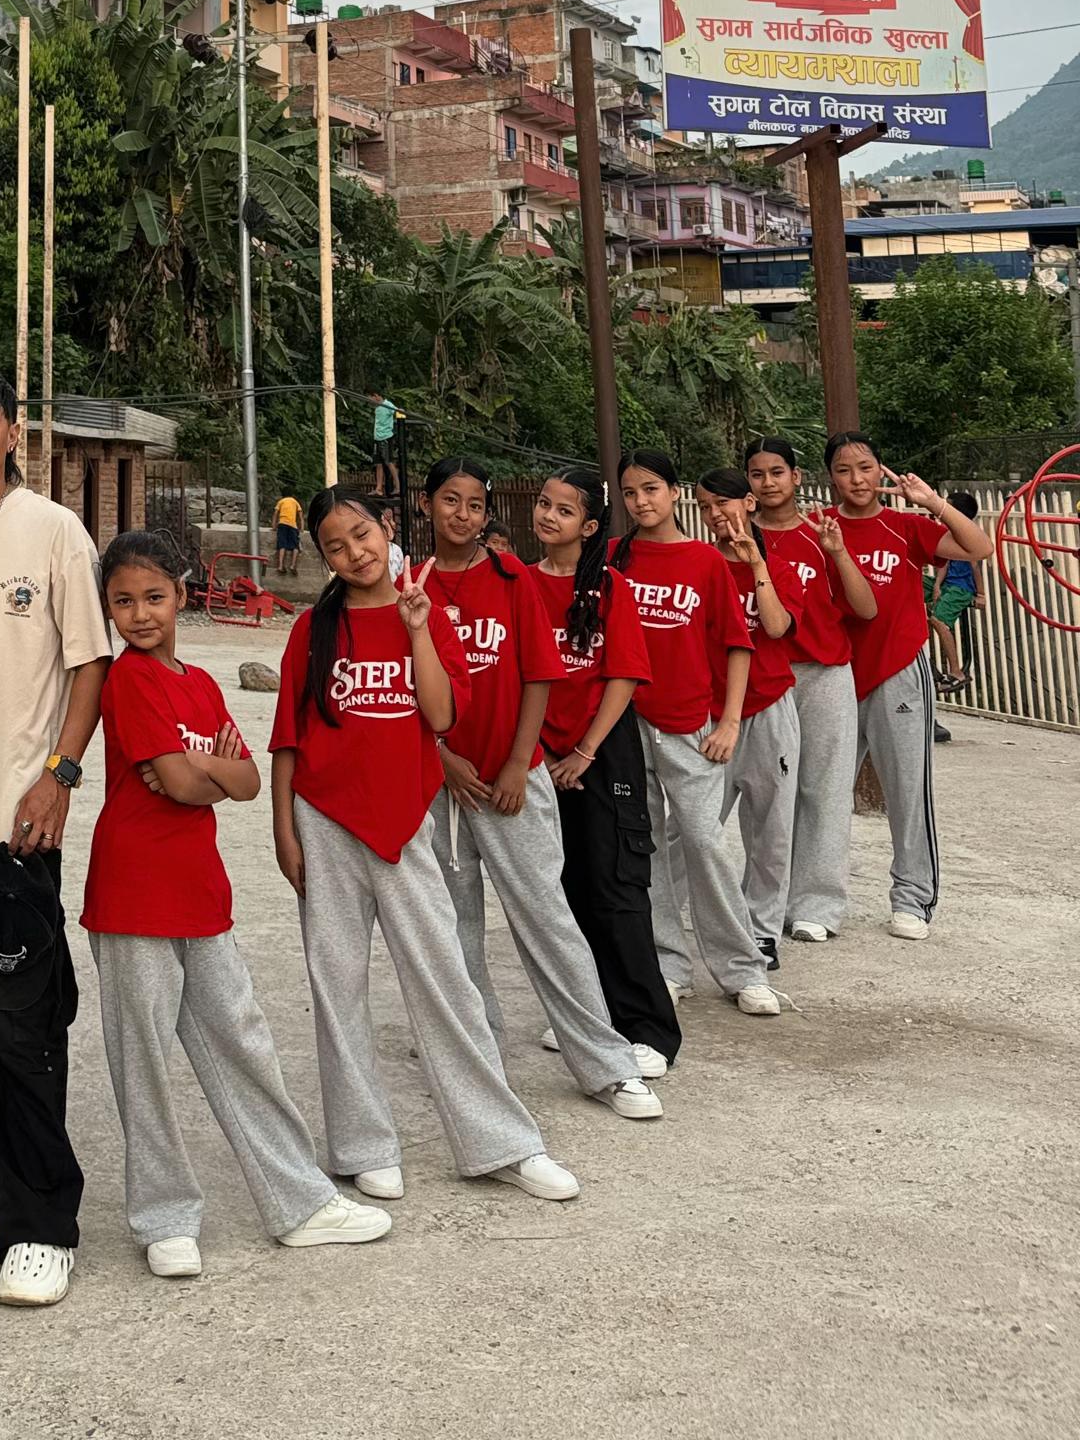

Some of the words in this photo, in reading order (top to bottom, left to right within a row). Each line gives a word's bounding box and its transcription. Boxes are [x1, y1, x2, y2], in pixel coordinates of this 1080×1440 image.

[696, 17, 754, 41] सुगम
[763, 18, 873, 45] सार्वजनिक
[883, 28, 949, 52] खुल्ला
[708, 95, 760, 117] सुगम
[770, 94, 811, 117] टोल
[820, 95, 884, 123] विकास
[893, 102, 947, 125] संस्था
[873, 550, 901, 575] UP
[673, 584, 701, 615] UP
[650, 607, 691, 626] ACADEMY
[475, 617, 507, 653] UP
[466, 653, 500, 665] ADEMY
[561, 654, 595, 668] ADEMY
[331, 658, 401, 700] STEP
[338, 693, 375, 711] DANCE
